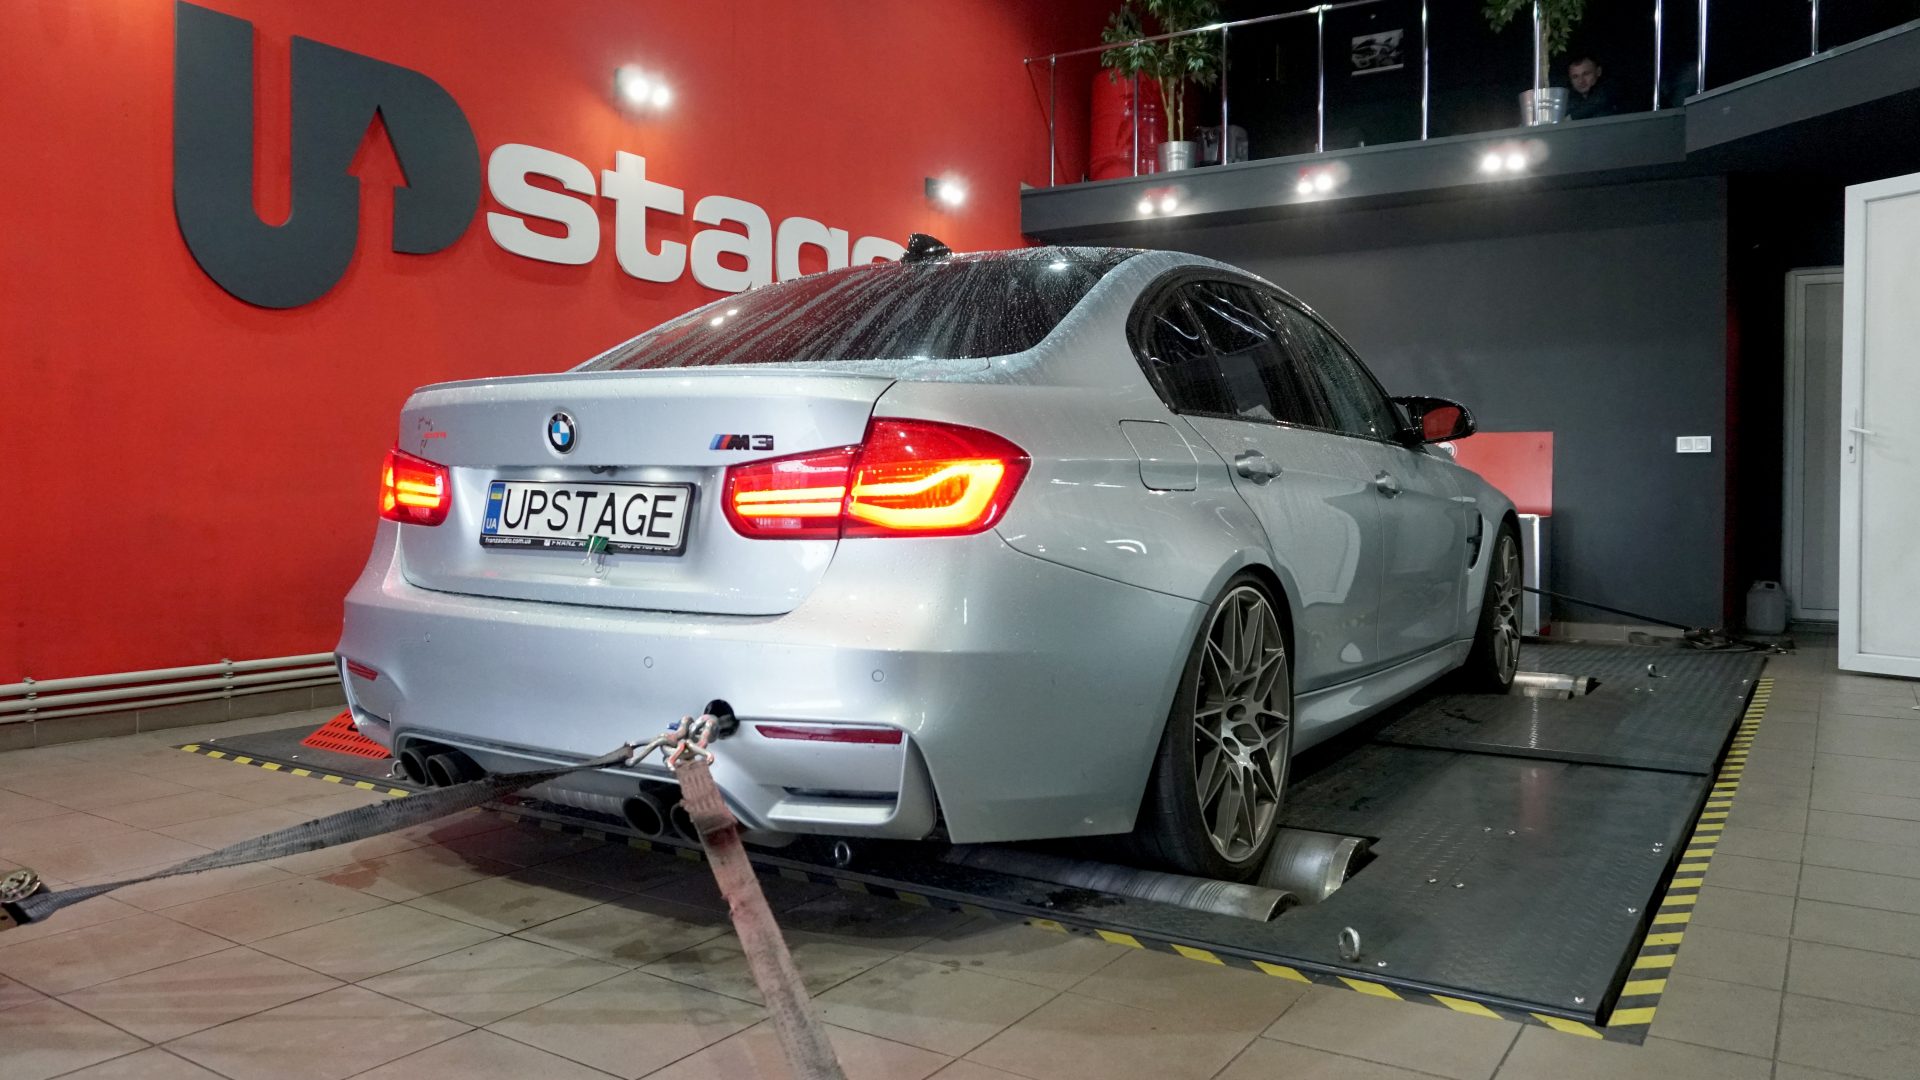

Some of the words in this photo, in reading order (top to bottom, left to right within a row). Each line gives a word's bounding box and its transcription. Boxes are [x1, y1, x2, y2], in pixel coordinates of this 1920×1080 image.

[725, 434, 774, 451] M3
[503, 488, 677, 538] UPSTAGE
[486, 517, 497, 529] UA
